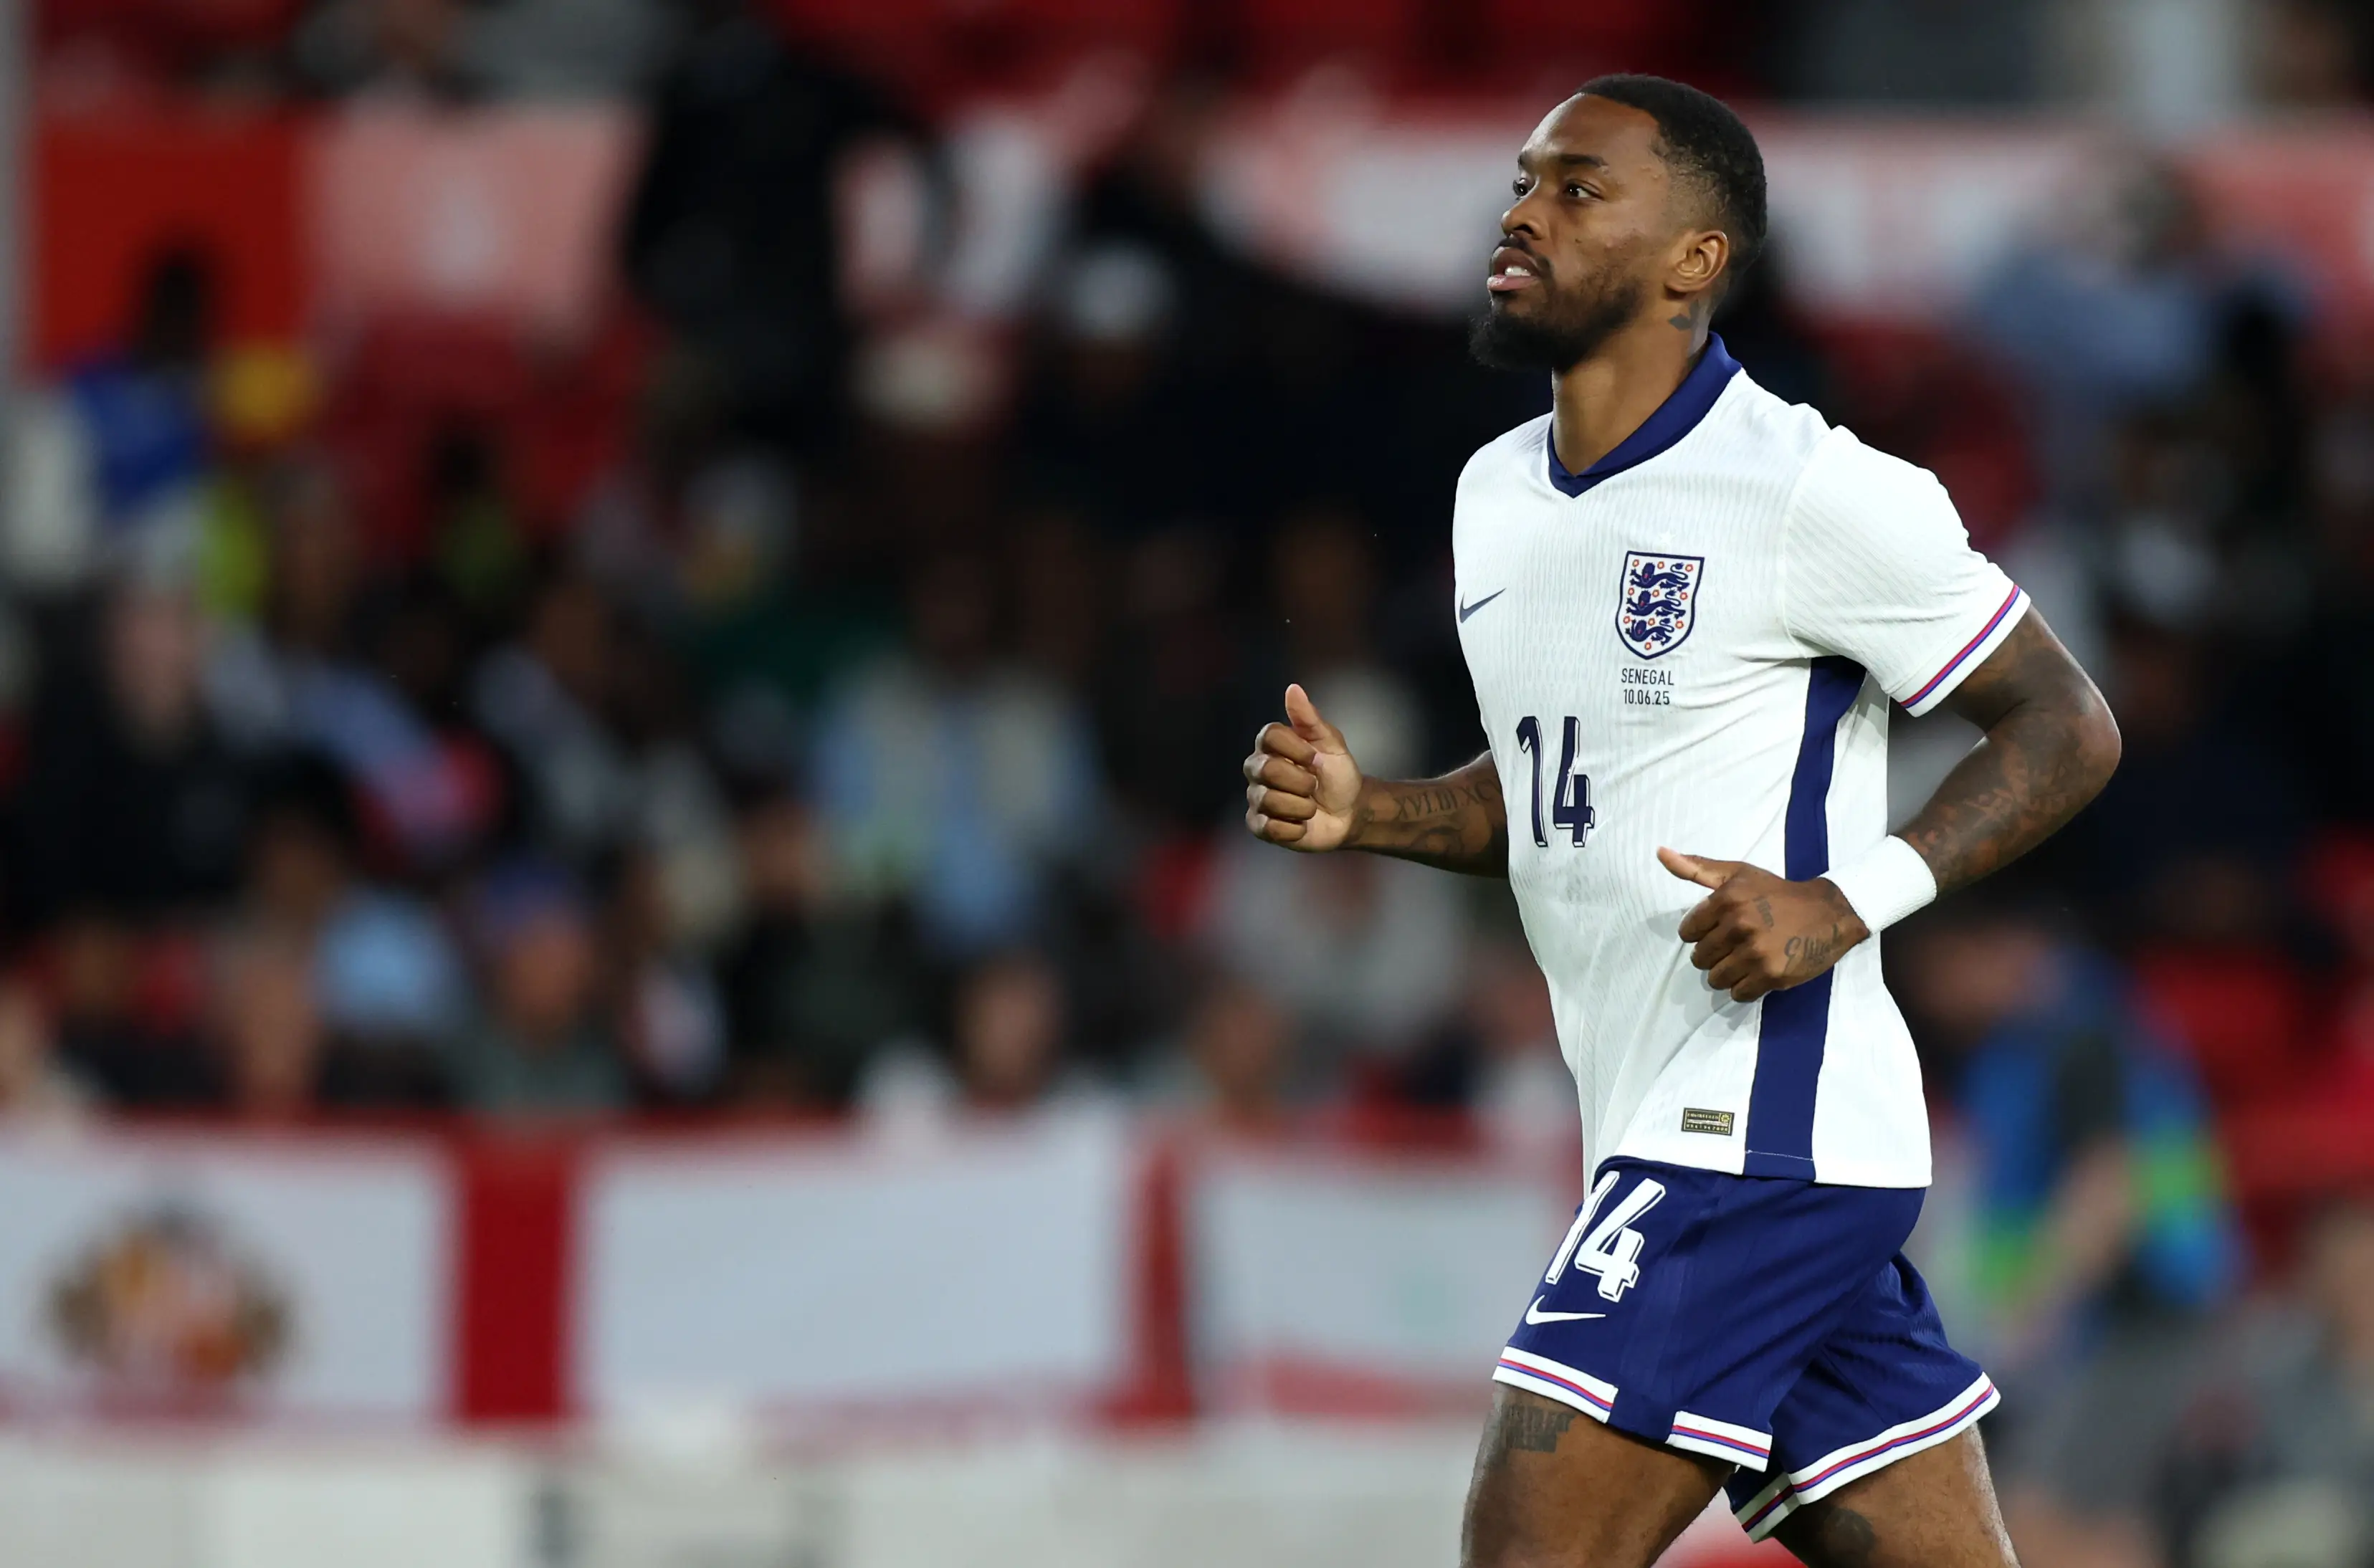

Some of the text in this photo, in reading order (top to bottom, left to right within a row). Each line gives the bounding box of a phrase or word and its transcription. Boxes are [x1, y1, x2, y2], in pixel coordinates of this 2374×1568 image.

[1621, 668, 1674, 685] SENEGAL
[1624, 689, 1670, 705] 10.06.25
[1516, 715, 1596, 848] 14
[1545, 1170, 1666, 1303] 14
